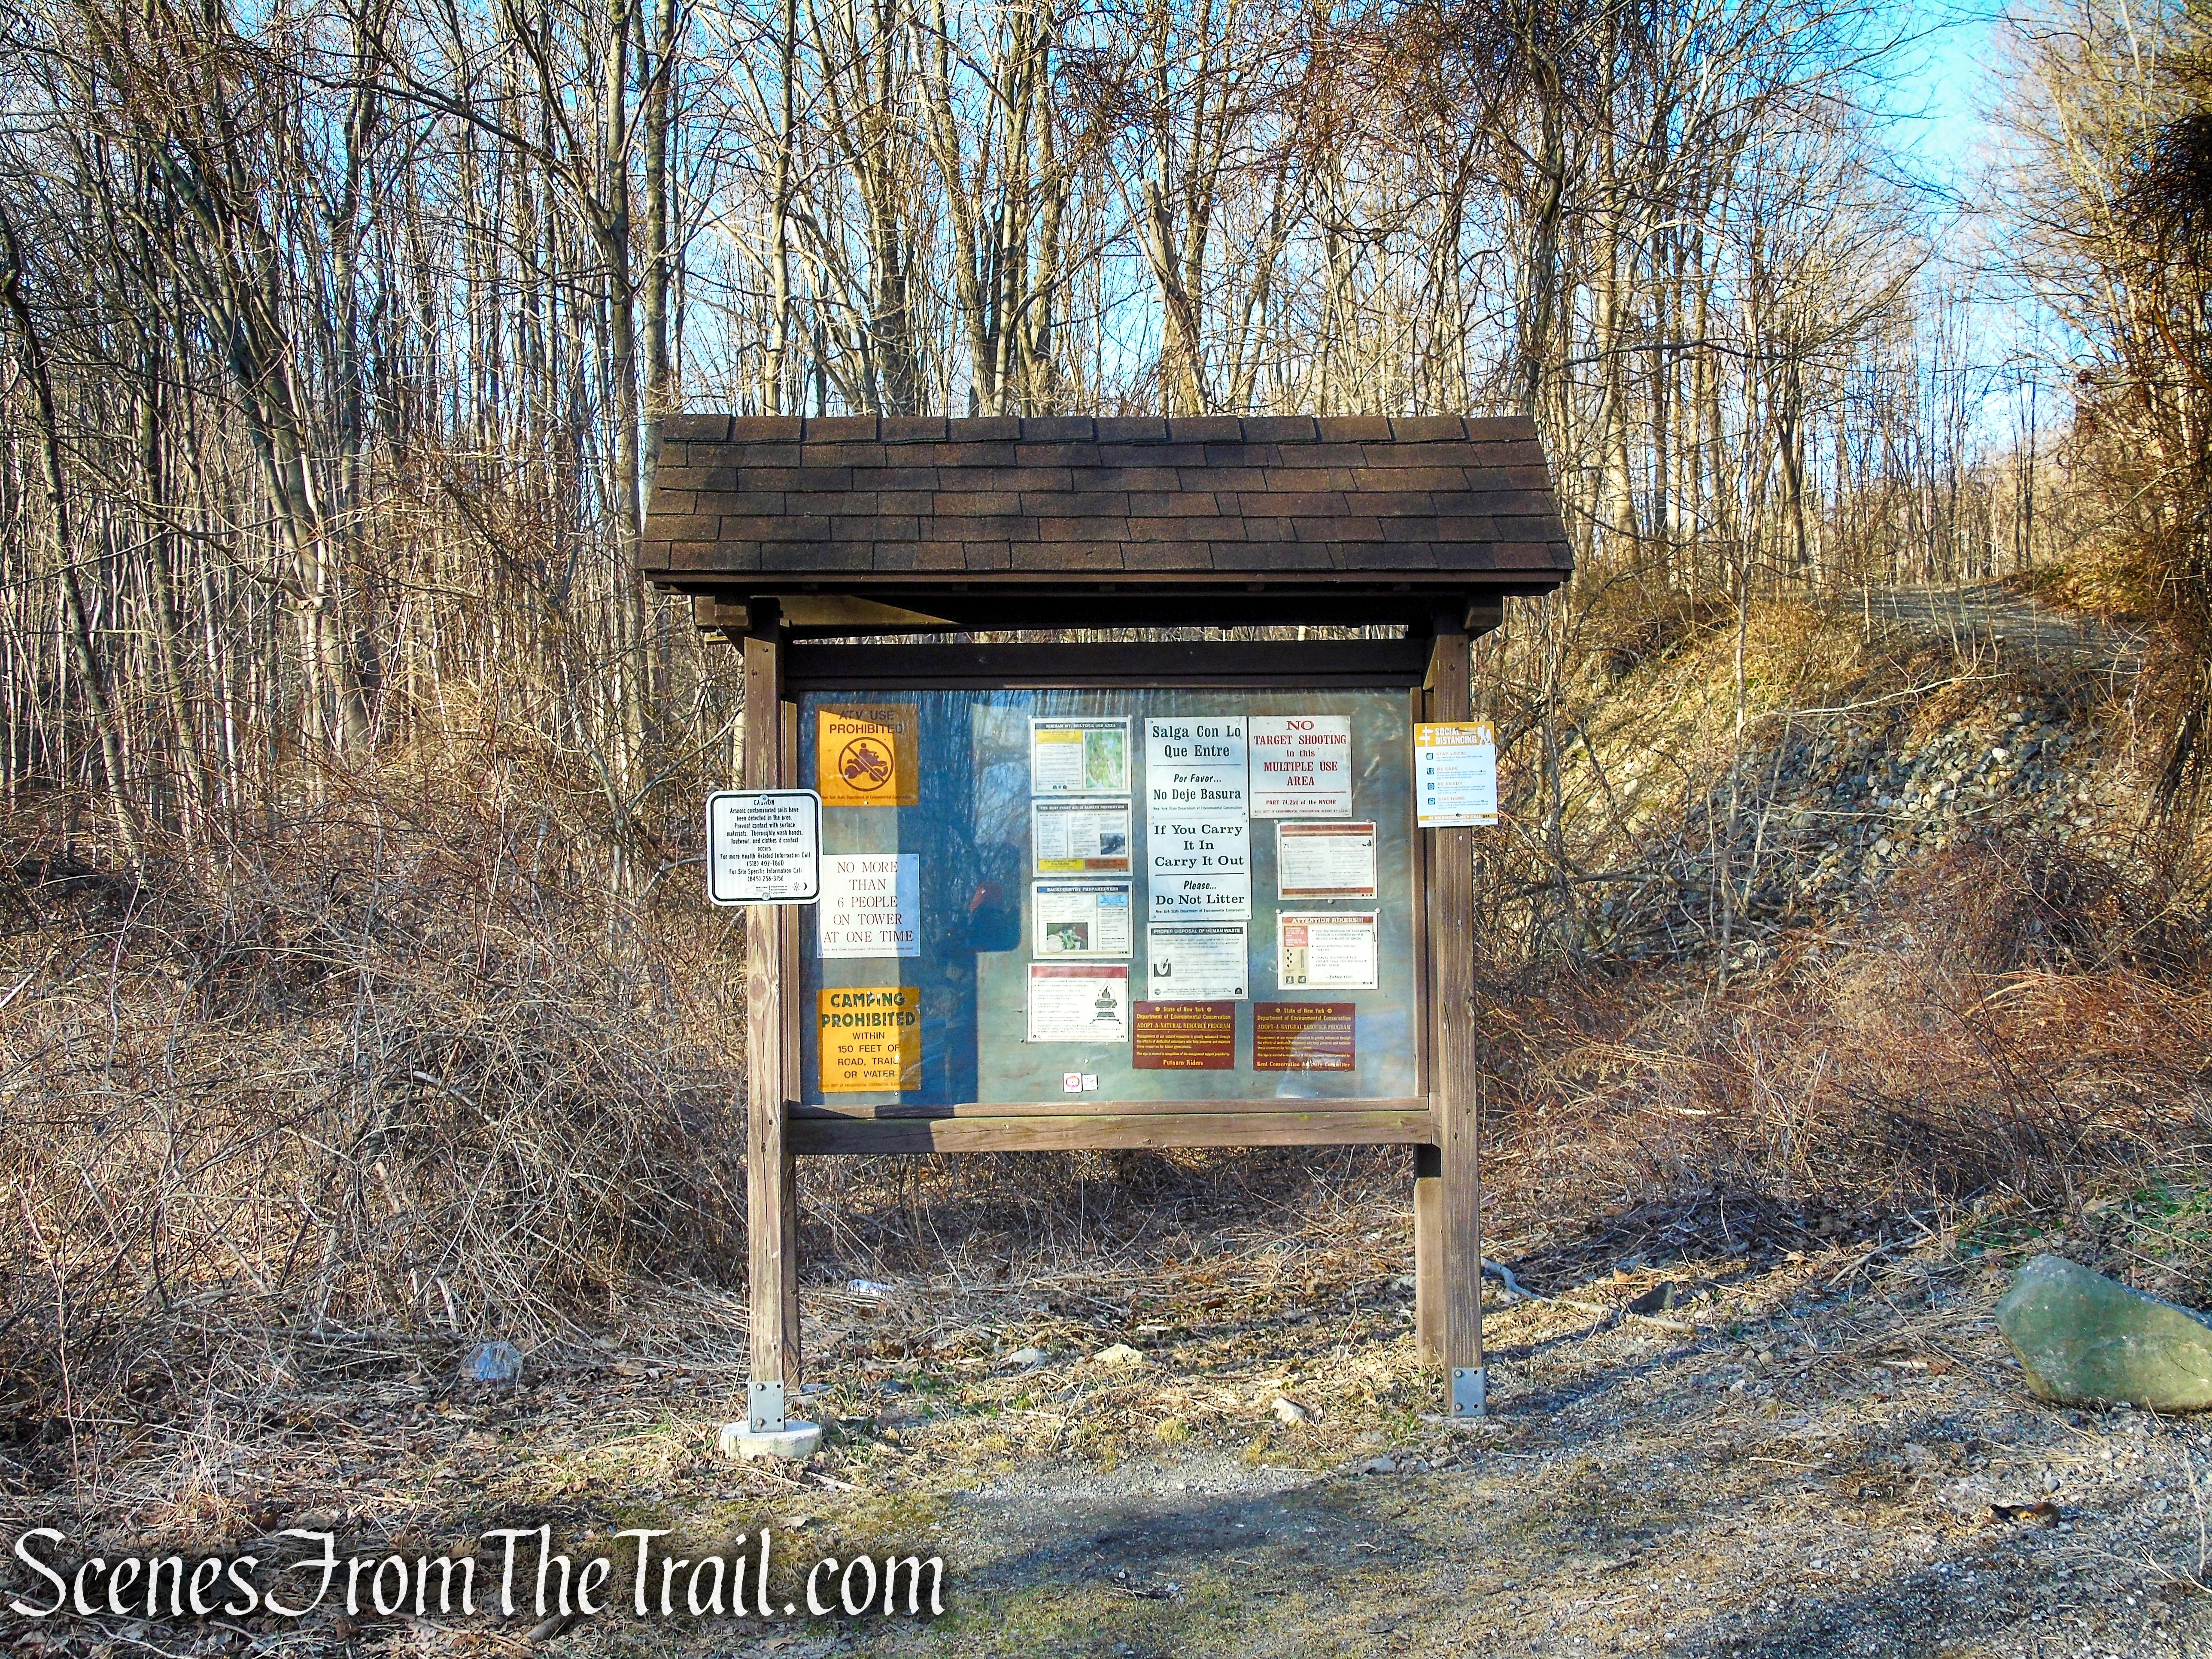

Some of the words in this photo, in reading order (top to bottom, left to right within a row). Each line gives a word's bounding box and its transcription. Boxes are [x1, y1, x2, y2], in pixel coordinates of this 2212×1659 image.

[839, 710, 863, 720] ATV
[871, 710, 895, 720] USE
[830, 724, 903, 734] PROHIBITED
[1286, 721, 1314, 730] NO
[1152, 726, 1189, 740] Salga
[1197, 726, 1218, 737] Con
[1227, 726, 1240, 737] Lo
[1435, 727, 1460, 735] SOCIAL
[1254, 735, 1292, 744] TARGET
[1299, 735, 1346, 744] SHOOTING
[1436, 736, 1477, 744] DISTANCING
[1165, 745, 1187, 758] Que
[1194, 745, 1229, 757] Entre
[1264, 762, 1313, 771] MULTIPLE
[1320, 761, 1337, 771] USE
[1174, 774, 1187, 782] Por
[1191, 774, 1221, 782] Favor...
[1287, 776, 1315, 785] AREA
[1154, 790, 1167, 799] No
[1172, 789, 1196, 802] Deje
[1201, 789, 1241, 799] Basura
[1155, 825, 1166, 835] If
[1172, 825, 1196, 834] You
[1202, 824, 1243, 836] Carry
[1184, 841, 1194, 850] It
[1199, 840, 1214, 849] In
[837, 862, 854, 872] NO
[862, 862, 898, 872] MORE
[1155, 857, 1197, 868] Carry
[1202, 856, 1212, 865] It
[1218, 856, 1244, 865] Out
[849, 879, 886, 890] THAN
[1184, 881, 1216, 889] Please...
[838, 897, 844, 908] 6
[852, 896, 897, 908] PEOPLE
[1156, 896, 1173, 905] Do
[1178, 895, 1201, 904] Not
[1206, 894, 1244, 903] Litter
[834, 915, 849, 925] ON
[858, 914, 902, 925] TOWER
[824, 932, 839, 942] AT
[847, 931, 872, 942] ONE
[880, 931, 913, 942] TIME
[831, 992, 905, 1007] CAMPING
[821, 1012, 915, 1027] PROHIBITED
